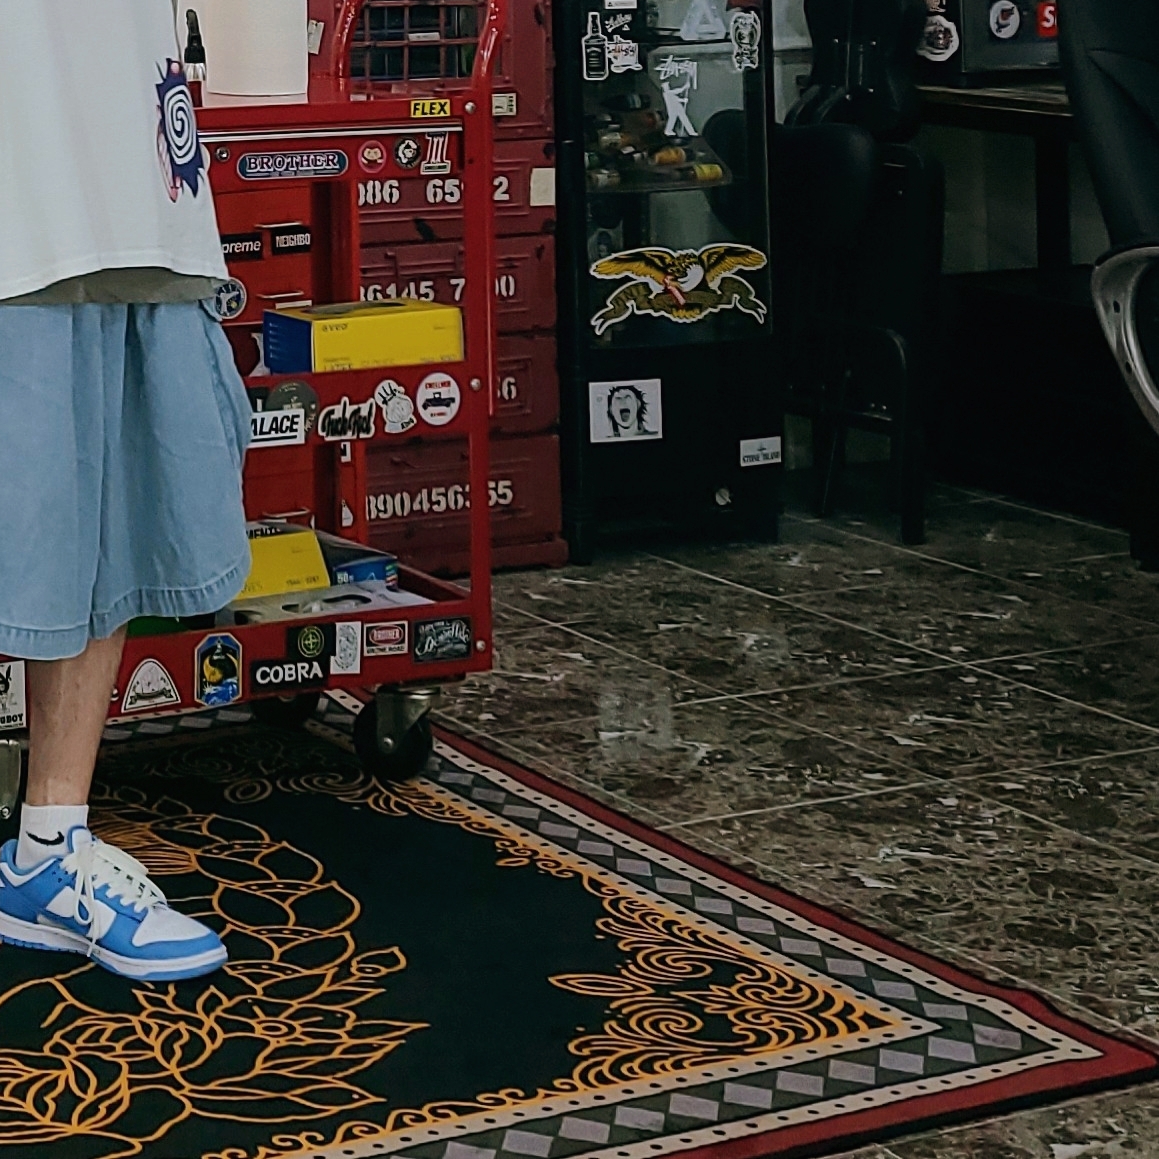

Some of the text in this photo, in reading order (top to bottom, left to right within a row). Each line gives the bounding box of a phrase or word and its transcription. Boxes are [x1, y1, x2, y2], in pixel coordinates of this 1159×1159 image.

[413, 102, 448, 116] FLEX
[245, 152, 340, 172] BROTHER
[255, 661, 323, 684] COBRA
